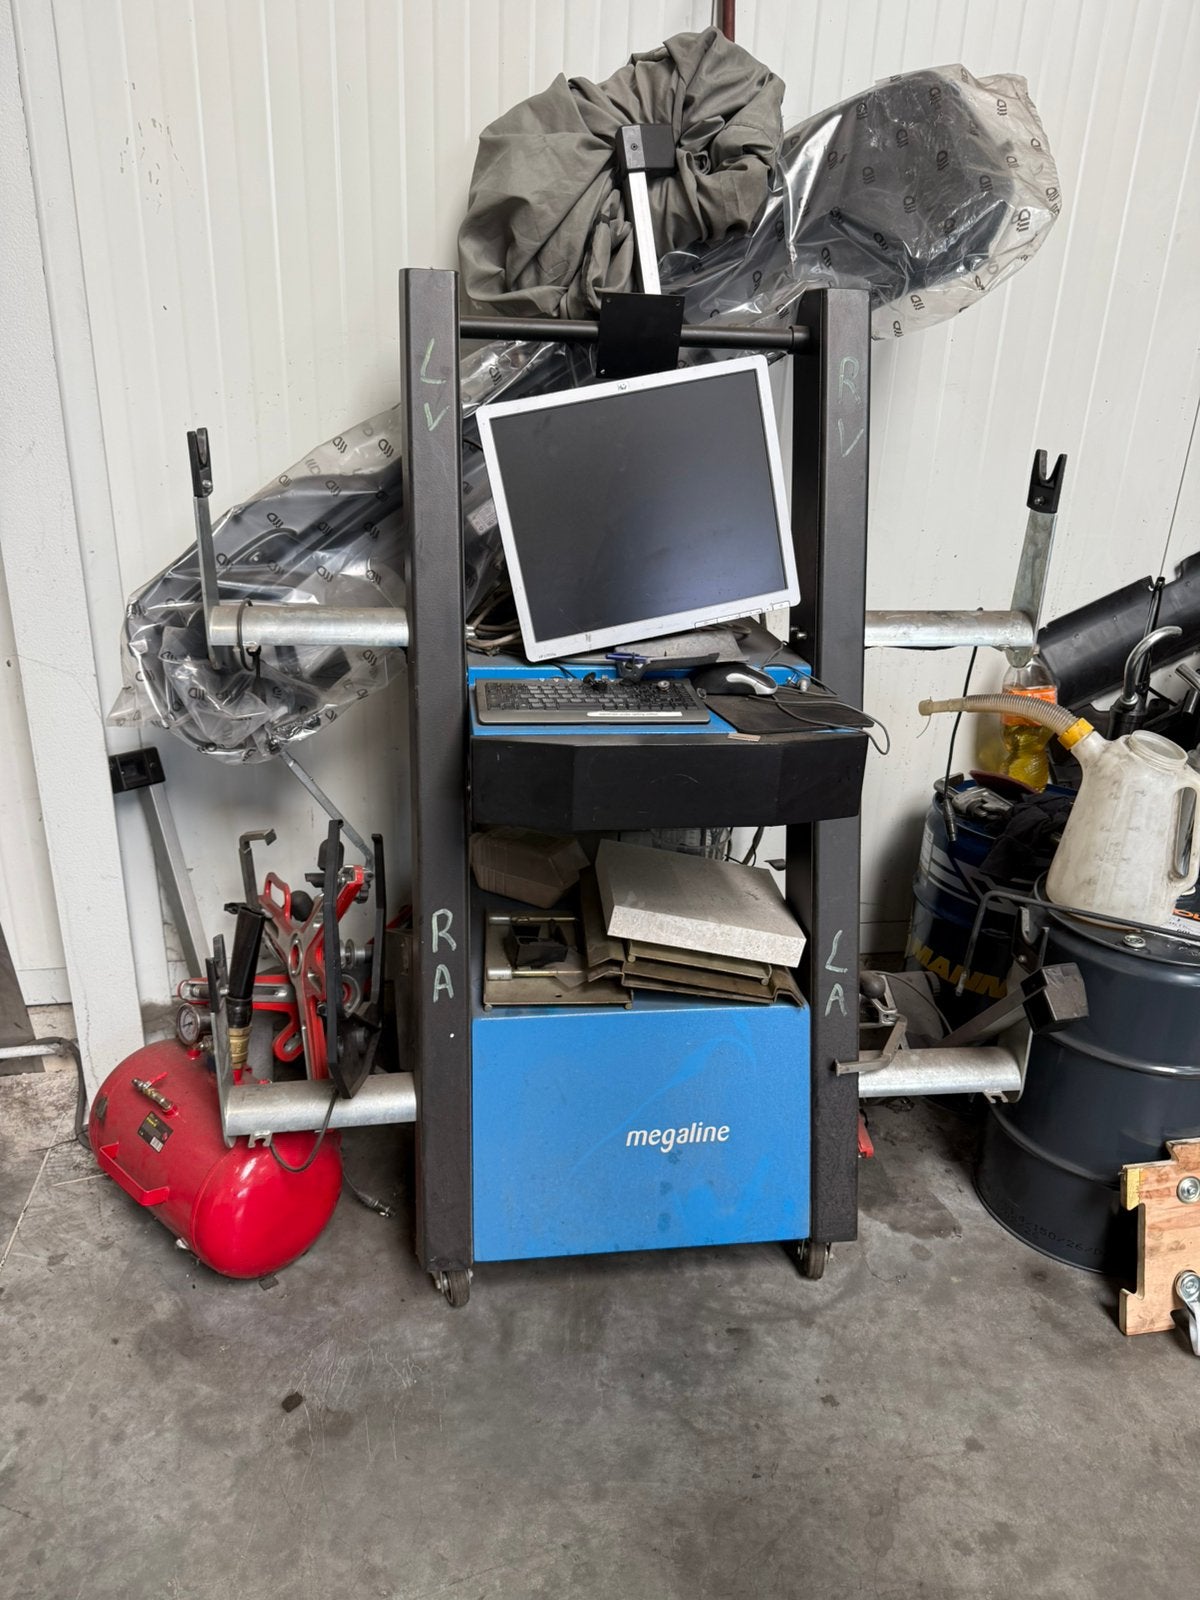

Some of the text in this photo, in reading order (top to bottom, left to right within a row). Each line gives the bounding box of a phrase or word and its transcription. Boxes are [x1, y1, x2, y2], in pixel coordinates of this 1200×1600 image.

[420, 338, 447, 384] L
[839, 356, 863, 405] R
[423, 402, 450, 432] V
[837, 418, 864, 457] V
[431, 908, 457, 953] R
[825, 929, 848, 973] L
[433, 964, 454, 1003] A
[824, 982, 848, 1016] A
[625, 1121, 731, 1154] megaline
